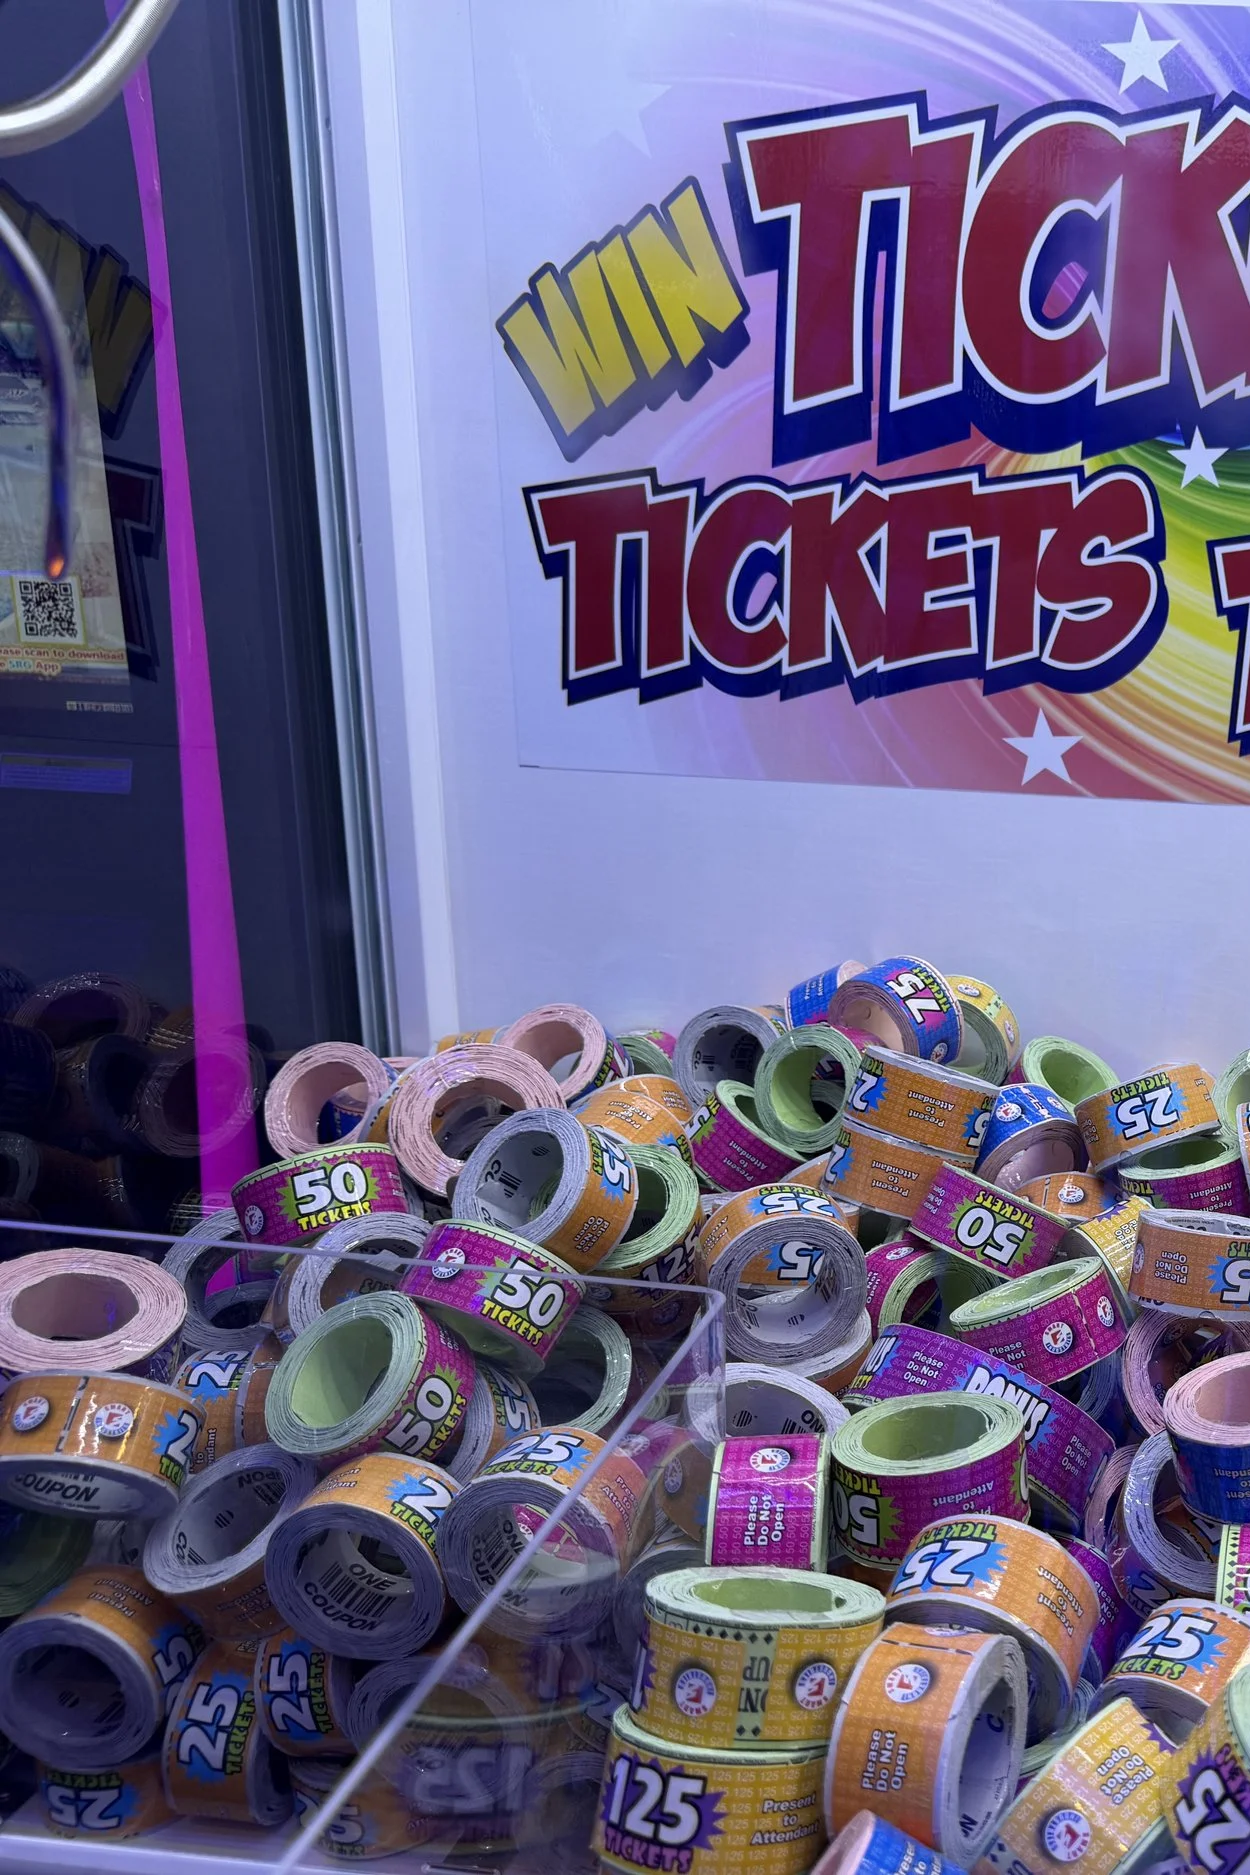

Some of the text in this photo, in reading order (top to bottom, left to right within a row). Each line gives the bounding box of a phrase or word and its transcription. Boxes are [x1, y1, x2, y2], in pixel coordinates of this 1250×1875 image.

[498, 178, 746, 450] WIN
[524, 466, 1164, 692] TICKETS
[24, 648, 124, 660] scan to download
[36, 662, 60, 673] App
[887, 971, 946, 1024] 75
[907, 1091, 955, 1112] Attendant
[1112, 1072, 1170, 1103] TICKETS
[907, 1109, 946, 1128] Present
[1115, 1087, 1180, 1140] 25
[723, 1158, 754, 1182] Present
[729, 1140, 768, 1170] Attendant
[871, 1160, 919, 1180] Attendant
[292, 1160, 368, 1216] 50
[761, 1191, 833, 1218] 25
[872, 1179, 909, 1197] Present
[1189, 1181, 1233, 1200] Attendant
[298, 1200, 372, 1232] TICKETS
[975, 1189, 1035, 1231] TICKETS
[955, 1206, 1028, 1266] 50
[1155, 1260, 1187, 1273] Do Not
[1161, 1250, 1187, 1263] Open
[493, 1258, 566, 1328] 50
[1154, 1269, 1187, 1284] Please
[481, 1298, 545, 1346] TICKETS
[912, 1351, 945, 1369] Please
[988, 1340, 1023, 1356] Please
[1006, 1348, 1026, 1363] Not
[902, 1371, 928, 1388] Open
[906, 1360, 940, 1379] Do Not
[384, 1374, 455, 1456] 50
[489, 1433, 585, 1468] 25
[1063, 1444, 1088, 1469] Do Not
[1070, 1435, 1092, 1458] Please
[1060, 1456, 1080, 1477] Open
[932, 1480, 994, 1507] Attendant
[963, 1501, 976, 1511] to
[744, 1495, 758, 1547] Please
[757, 1494, 772, 1547] Do Not
[771, 1503, 786, 1542] Open
[913, 1522, 998, 1544] TICKETS
[349, 1563, 397, 1592] ONE
[893, 1540, 989, 1596] 25
[303, 1581, 378, 1632] COUPON
[1037, 1566, 1084, 1618] Attendant
[1038, 1592, 1076, 1637] Present
[1121, 1614, 1217, 1661] 25
[267, 1652, 313, 1734] 25
[309, 1652, 332, 1734] TICKETS
[178, 1681, 240, 1773] 25
[223, 1690, 258, 1776] TICKETS
[861, 1729, 882, 1791] Please
[876, 1730, 898, 1793] Do Not
[890, 1742, 910, 1791] Open
[1096, 1745, 1131, 1775] Open
[1100, 1753, 1145, 1797] Do Not
[610, 1754, 707, 1846] 125
[1111, 1764, 1155, 1806] Please
[46, 1783, 122, 1831] 25
[761, 1792, 817, 1817] Present
[783, 1812, 799, 1827] to
[750, 1817, 821, 1848] Attendant
[604, 1829, 694, 1874] TICKETS
